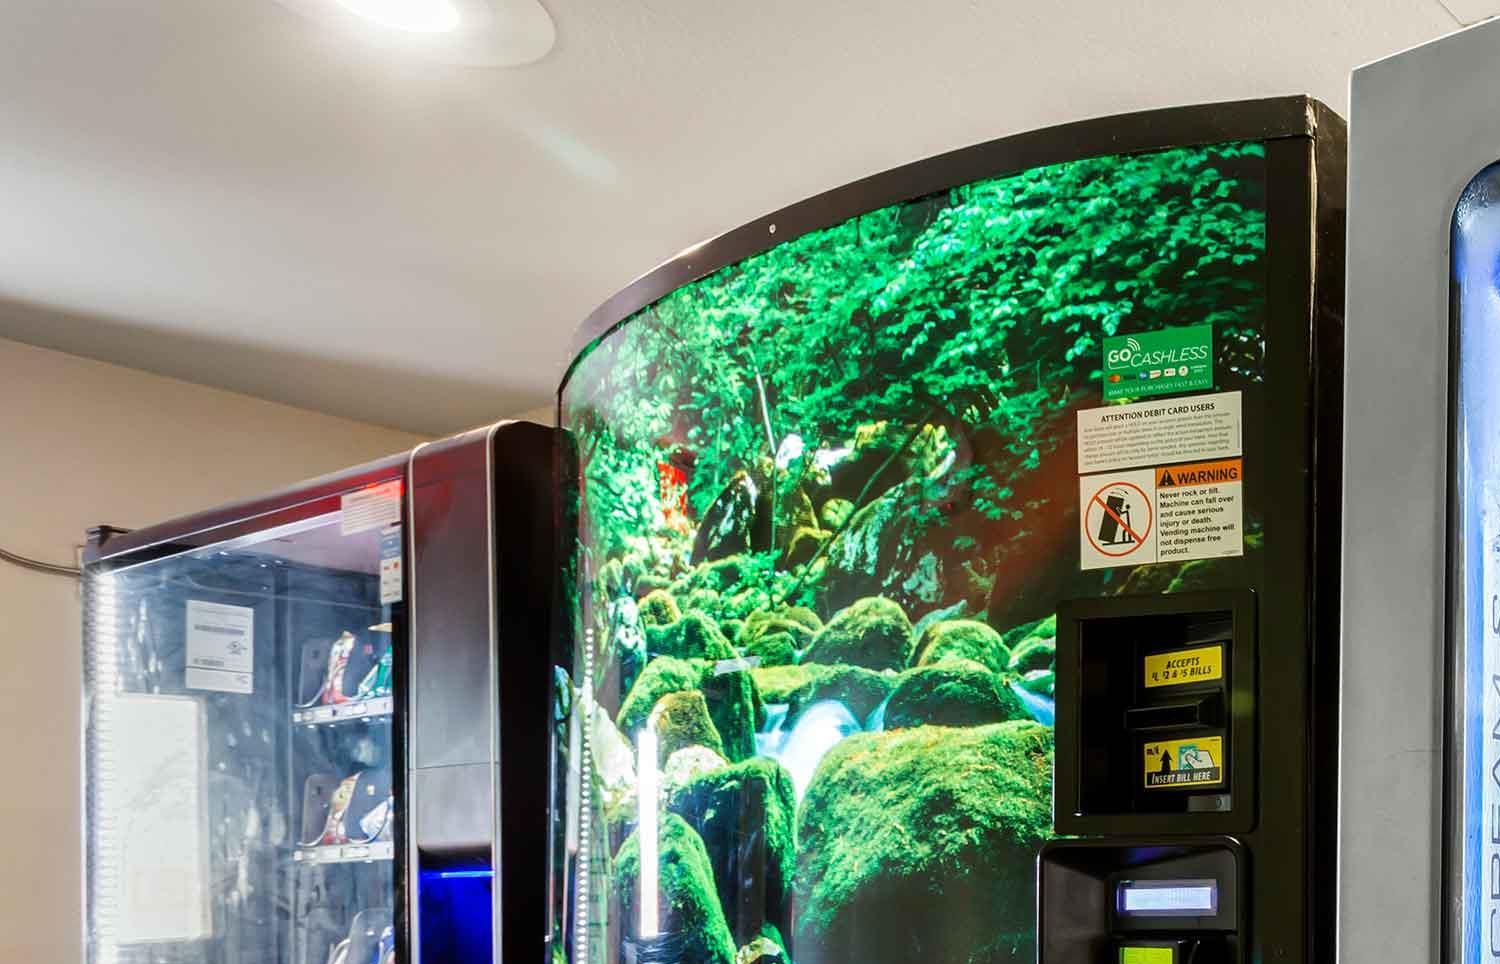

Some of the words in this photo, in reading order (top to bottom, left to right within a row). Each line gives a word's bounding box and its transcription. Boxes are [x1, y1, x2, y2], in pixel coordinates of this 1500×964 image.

[1108, 349, 1131, 363] GO
[1131, 346, 1208, 367] CASHLESS
[1101, 411, 1142, 422] ATTENTION
[1144, 408, 1166, 417] DEBIT
[1167, 405, 1189, 415] CARD
[1190, 402, 1215, 412] USERS
[1177, 467, 1238, 484] WARNING
[1160, 491, 1180, 499] Never
[1182, 488, 1197, 497] rock
[1160, 499, 1189, 508] Machine
[1191, 498, 1204, 506] can
[1205, 496, 1217, 504] fall
[1218, 495, 1234, 503] over
[1160, 510, 1174, 518] and
[1175, 509, 1196, 517] cause
[1197, 506, 1224, 514] serious
[1160, 520, 1180, 528] injury
[1160, 528, 1189, 537] Vending
[1190, 526, 1221, 534] machine
[1160, 538, 1172, 546] not
[1173, 537, 1206, 545] dispense
[1207, 534, 1222, 542] free
[1166, 656, 1200, 669] ACCEPTS
[1190, 665, 1212, 676] BILLS
[1151, 772, 1176, 785] INSERT
[1176, 772, 1191, 783] BILL
[1193, 770, 1212, 781] HERE
